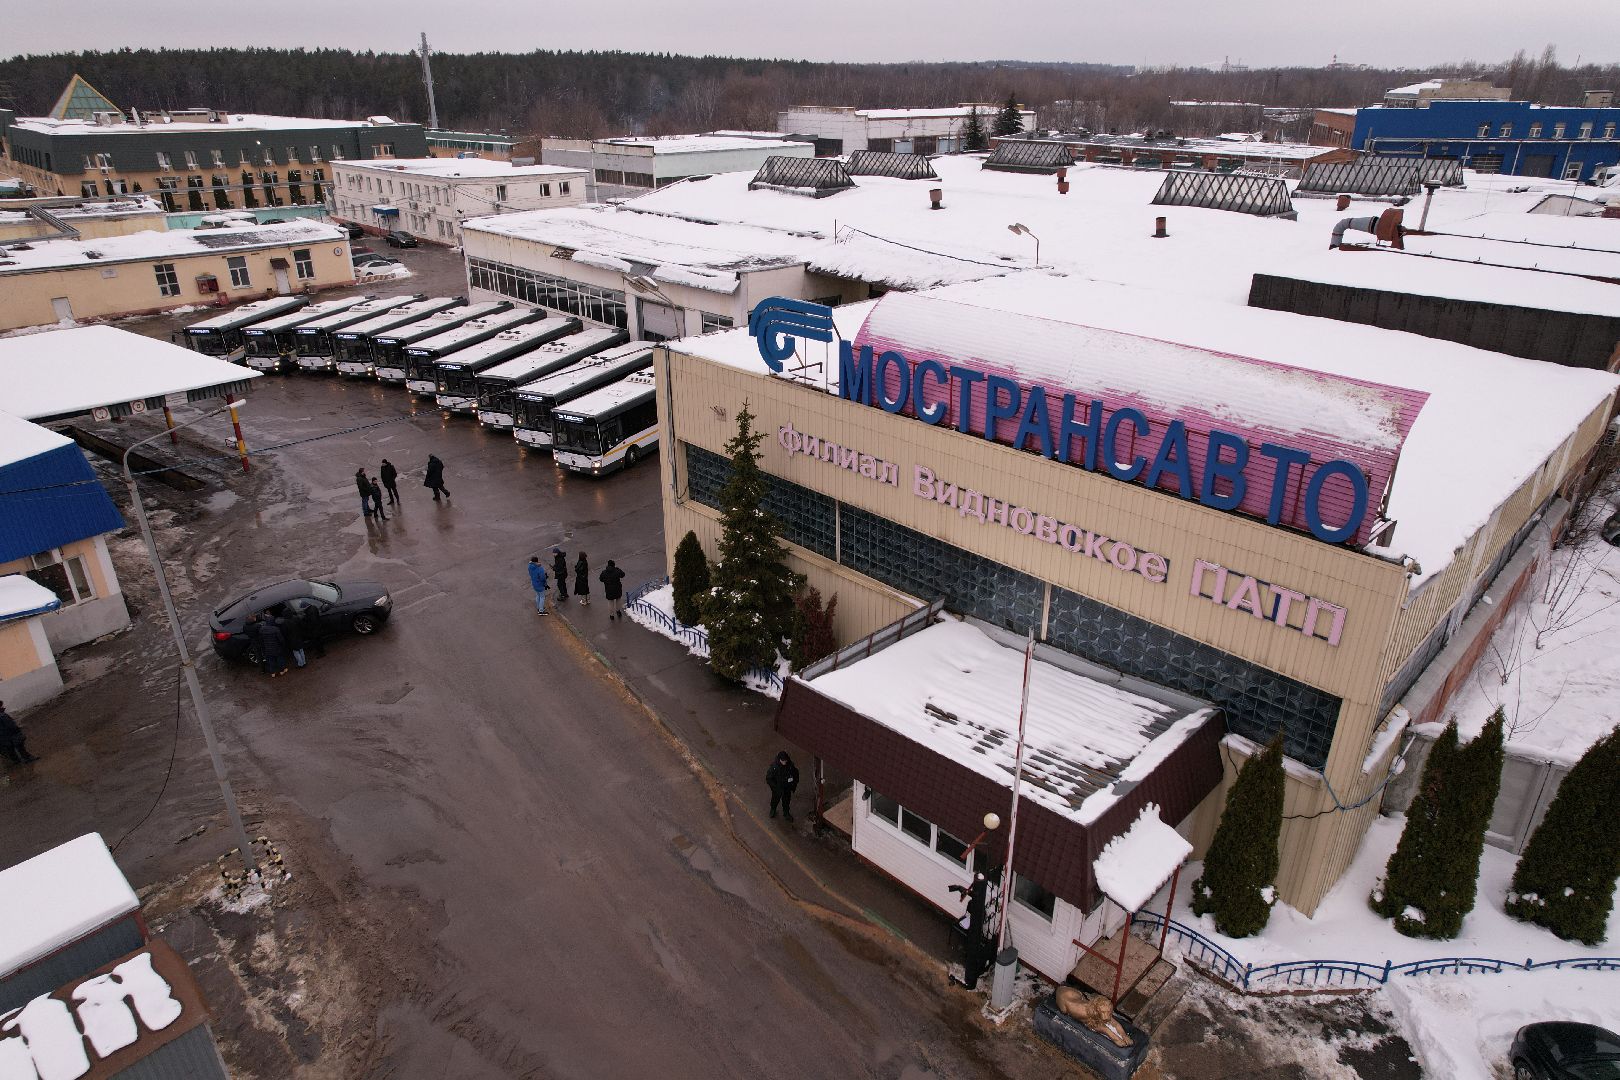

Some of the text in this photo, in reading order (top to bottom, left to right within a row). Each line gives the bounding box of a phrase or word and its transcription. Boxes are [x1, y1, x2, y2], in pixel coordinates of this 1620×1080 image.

[778, 423, 1349, 647] филиал Видновское ПАТП
[838, 339, 1369, 543] МОСТРАНСАВТО
